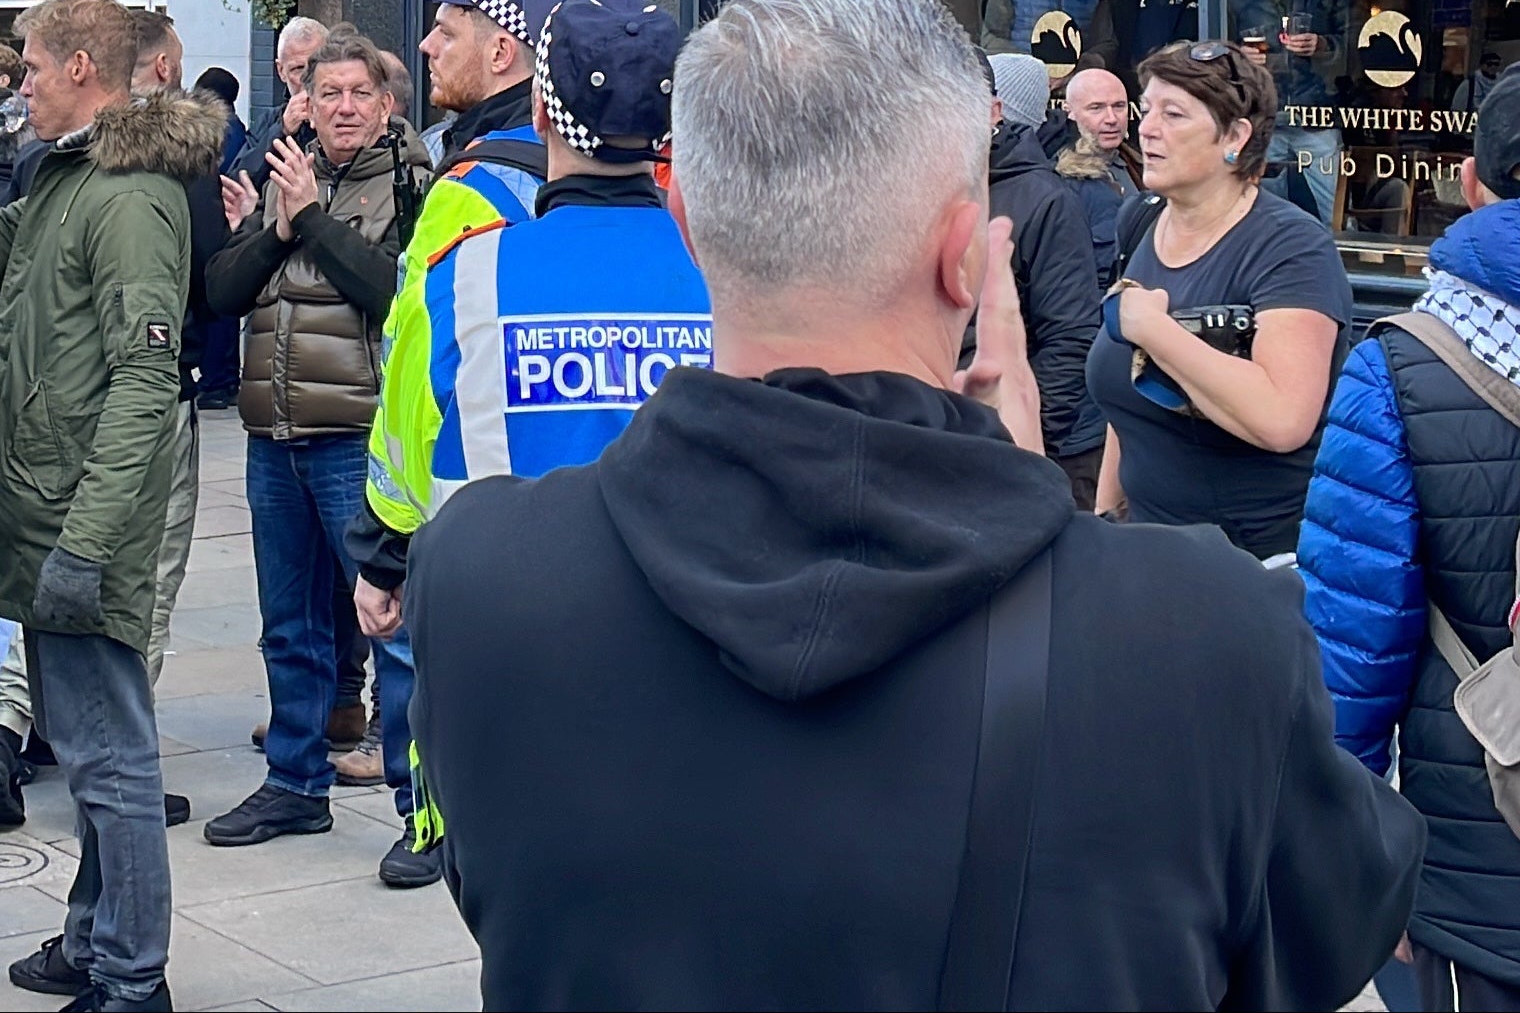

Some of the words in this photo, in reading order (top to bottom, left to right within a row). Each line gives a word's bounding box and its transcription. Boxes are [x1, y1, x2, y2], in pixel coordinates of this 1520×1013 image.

[1284, 105, 1334, 128] THE
[1338, 107, 1424, 131] WHITE
[1430, 110, 1478, 133] SWA
[1297, 150, 1356, 177] Pub
[1376, 154, 1463, 182] Dinin
[516, 326, 712, 350] METROPOLITAN
